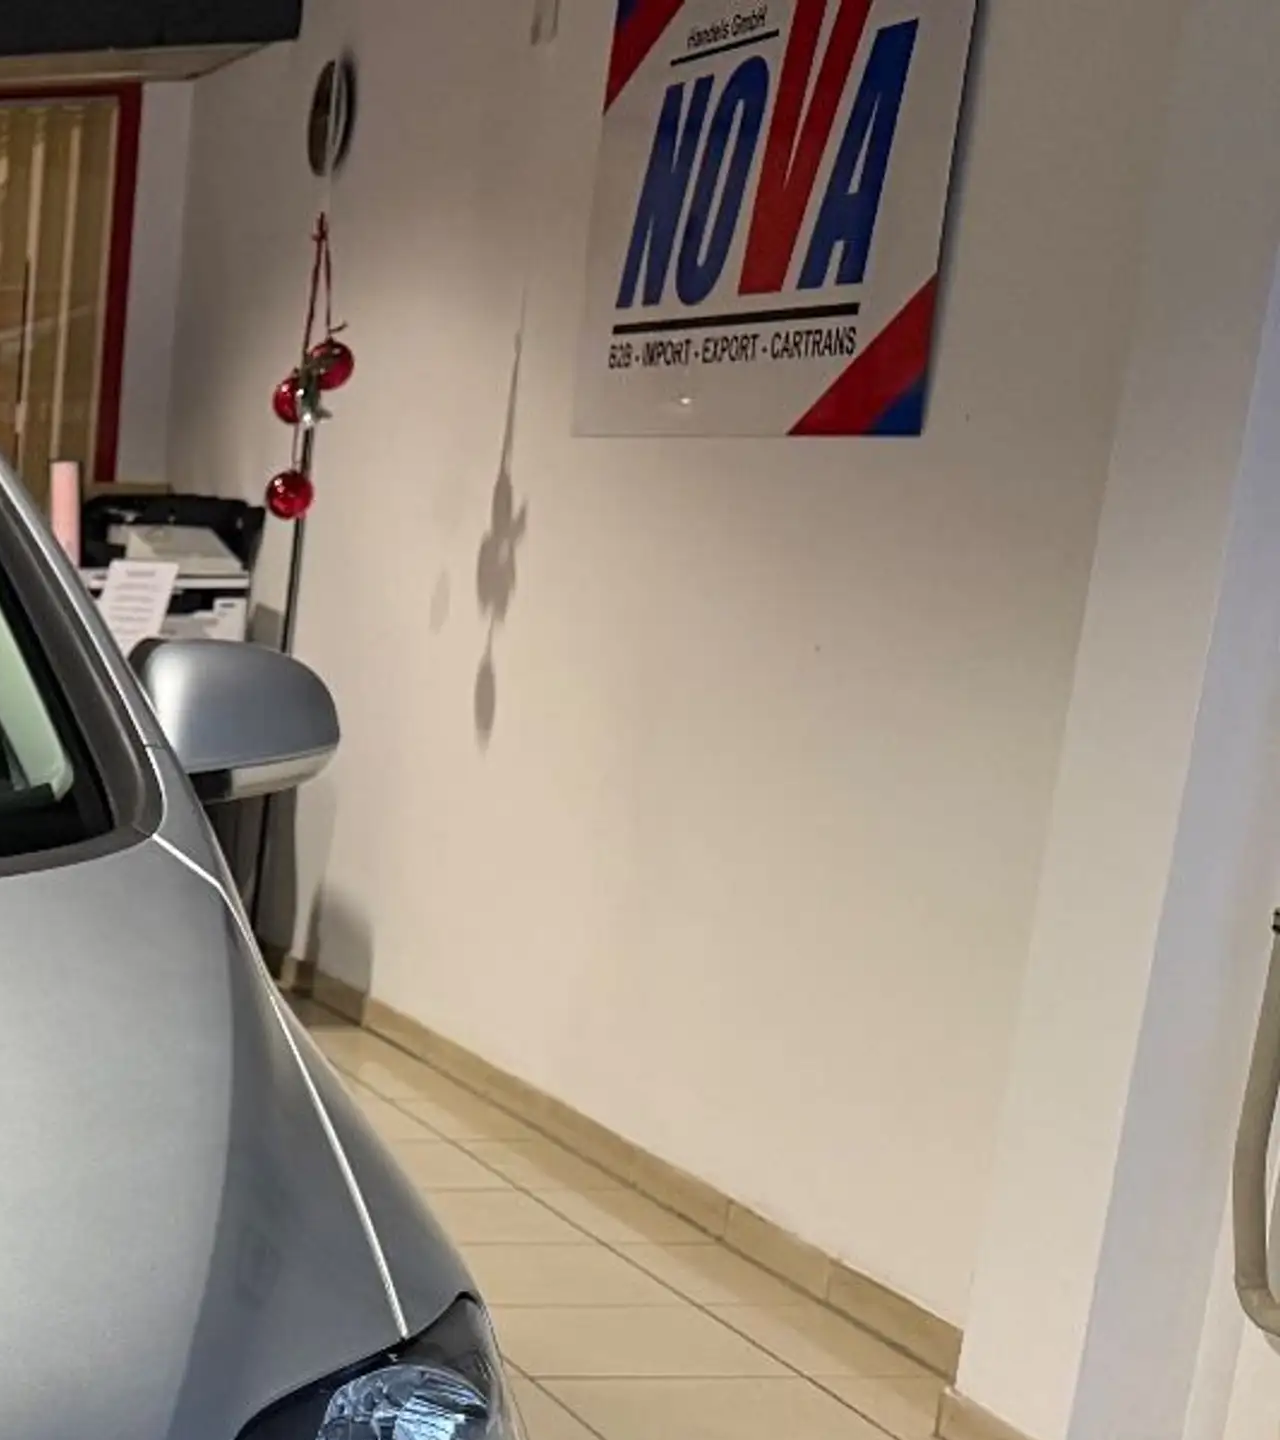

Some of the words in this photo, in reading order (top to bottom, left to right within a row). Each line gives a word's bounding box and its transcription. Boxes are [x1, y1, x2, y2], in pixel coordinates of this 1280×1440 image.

[615, 0, 919, 308] NOVA
[608, 342, 633, 369] B2B
[642, 338, 691, 367] IMPORT
[702, 333, 760, 364] EXPORT
[770, 326, 857, 360] CARTRANS
